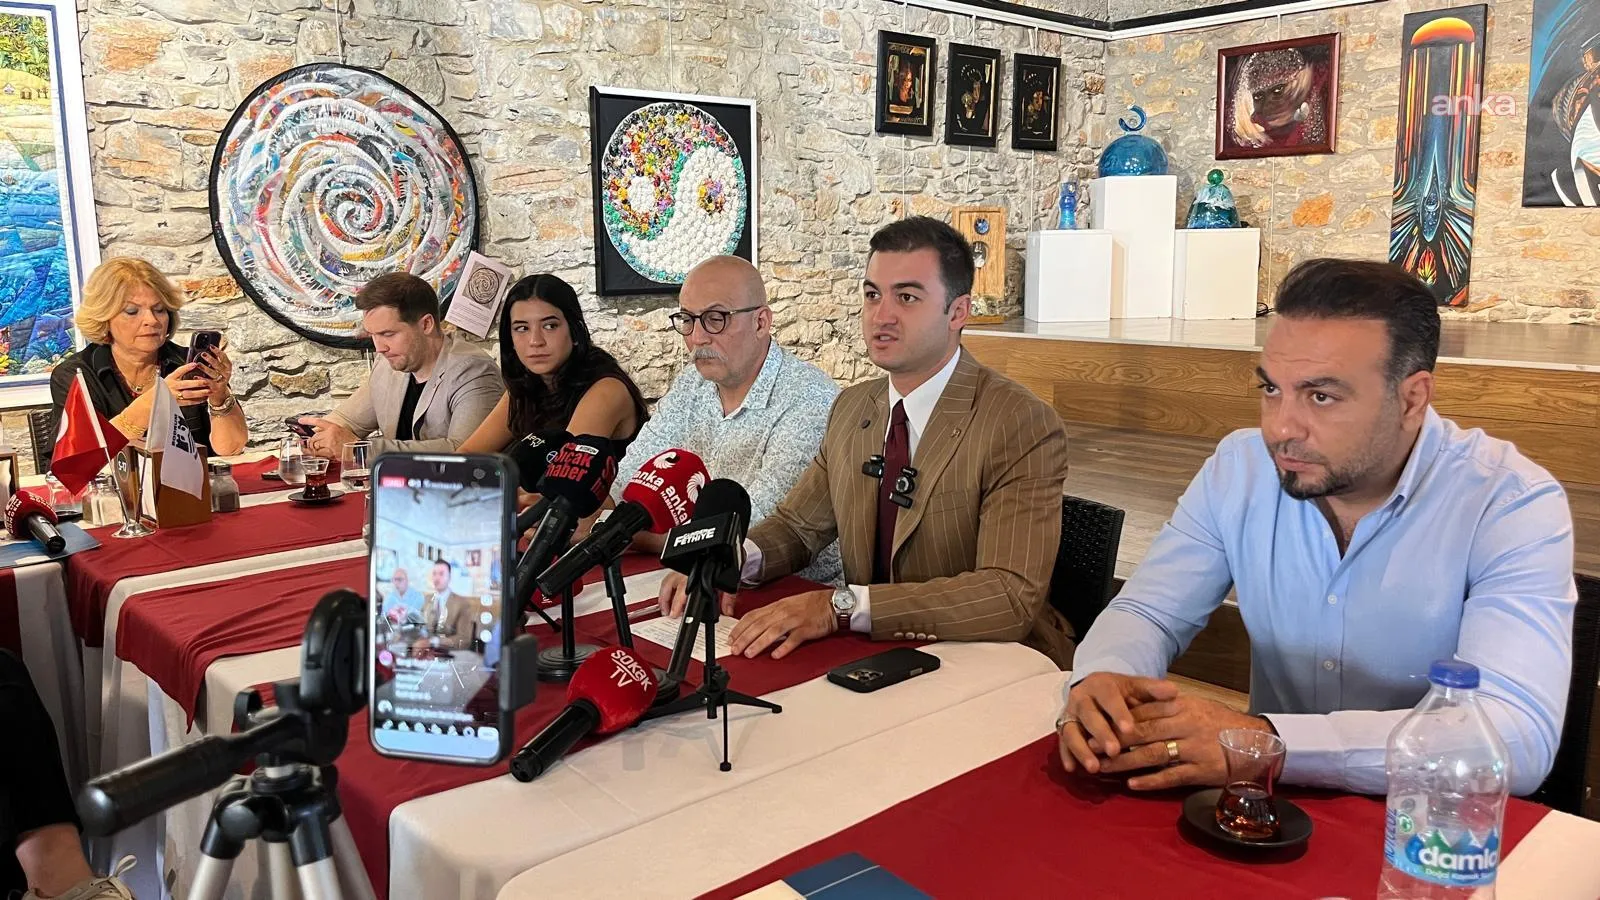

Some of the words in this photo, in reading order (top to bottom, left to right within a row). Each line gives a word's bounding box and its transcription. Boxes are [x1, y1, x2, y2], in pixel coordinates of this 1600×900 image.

[633, 470, 664, 488] anka
[665, 485, 688, 523] anka
[610, 665, 633, 688] TV
